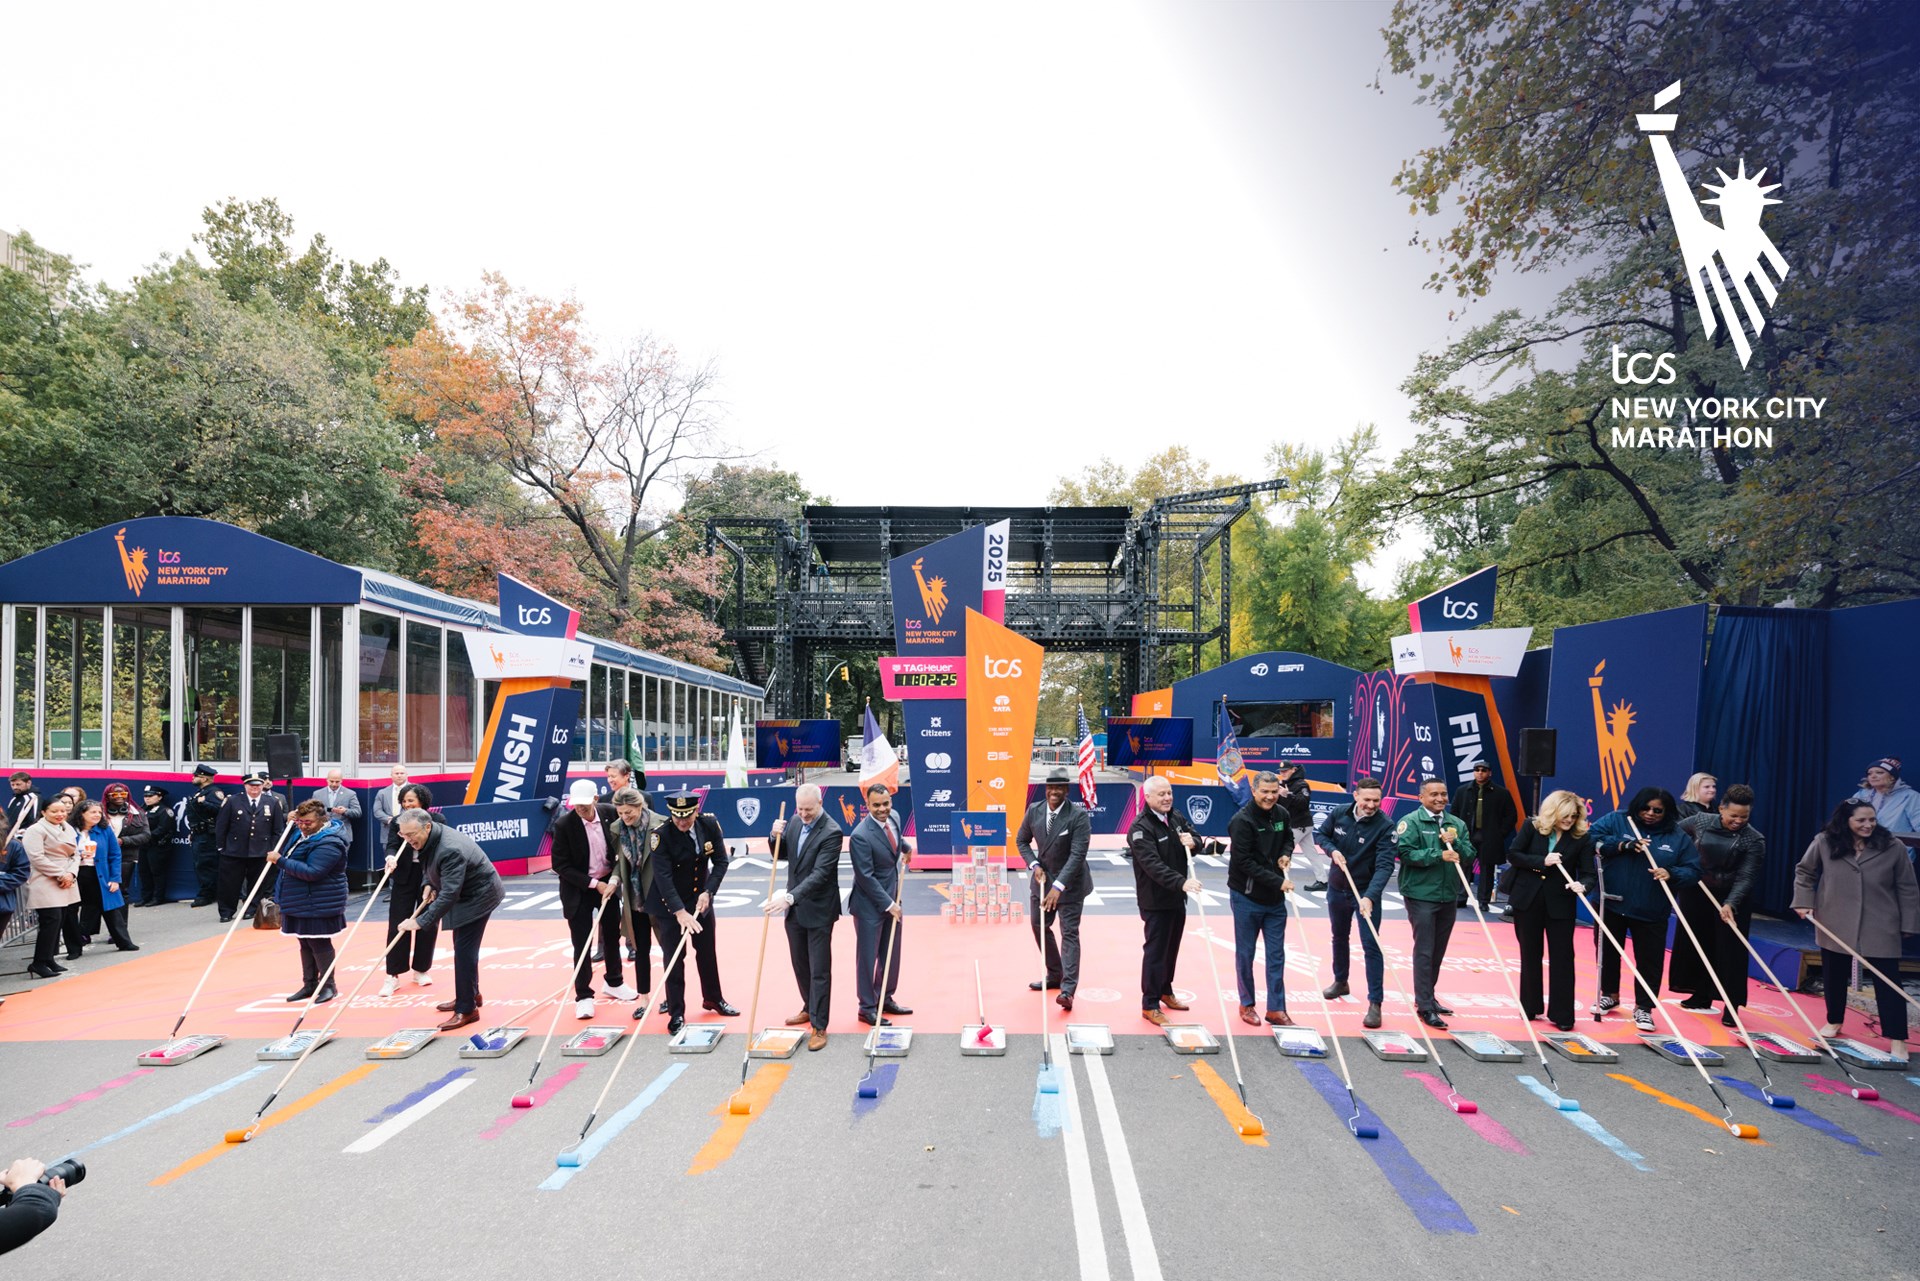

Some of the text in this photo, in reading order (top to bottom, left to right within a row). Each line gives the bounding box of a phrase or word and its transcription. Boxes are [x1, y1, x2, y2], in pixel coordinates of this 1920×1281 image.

[158, 548, 181, 564] tcs
[988, 534, 1004, 583] 2025
[157, 566, 229, 576] NEW YORK CITY
[157, 576, 210, 585] MARATHON
[1443, 595, 1479, 620] tcs
[518, 604, 552, 626] tcs
[905, 618, 922, 629] tcs
[984, 654, 1023, 679] tcs
[1278, 664, 1304, 672] ESPN
[552, 724, 569, 745] tcs
[920, 729, 952, 737] Citizens
[1413, 721, 1432, 742] tcs
[545, 774, 559, 783] TATA
[456, 819, 520, 833] CENTRAL PARK
[481, 962, 557, 971] ROAD
